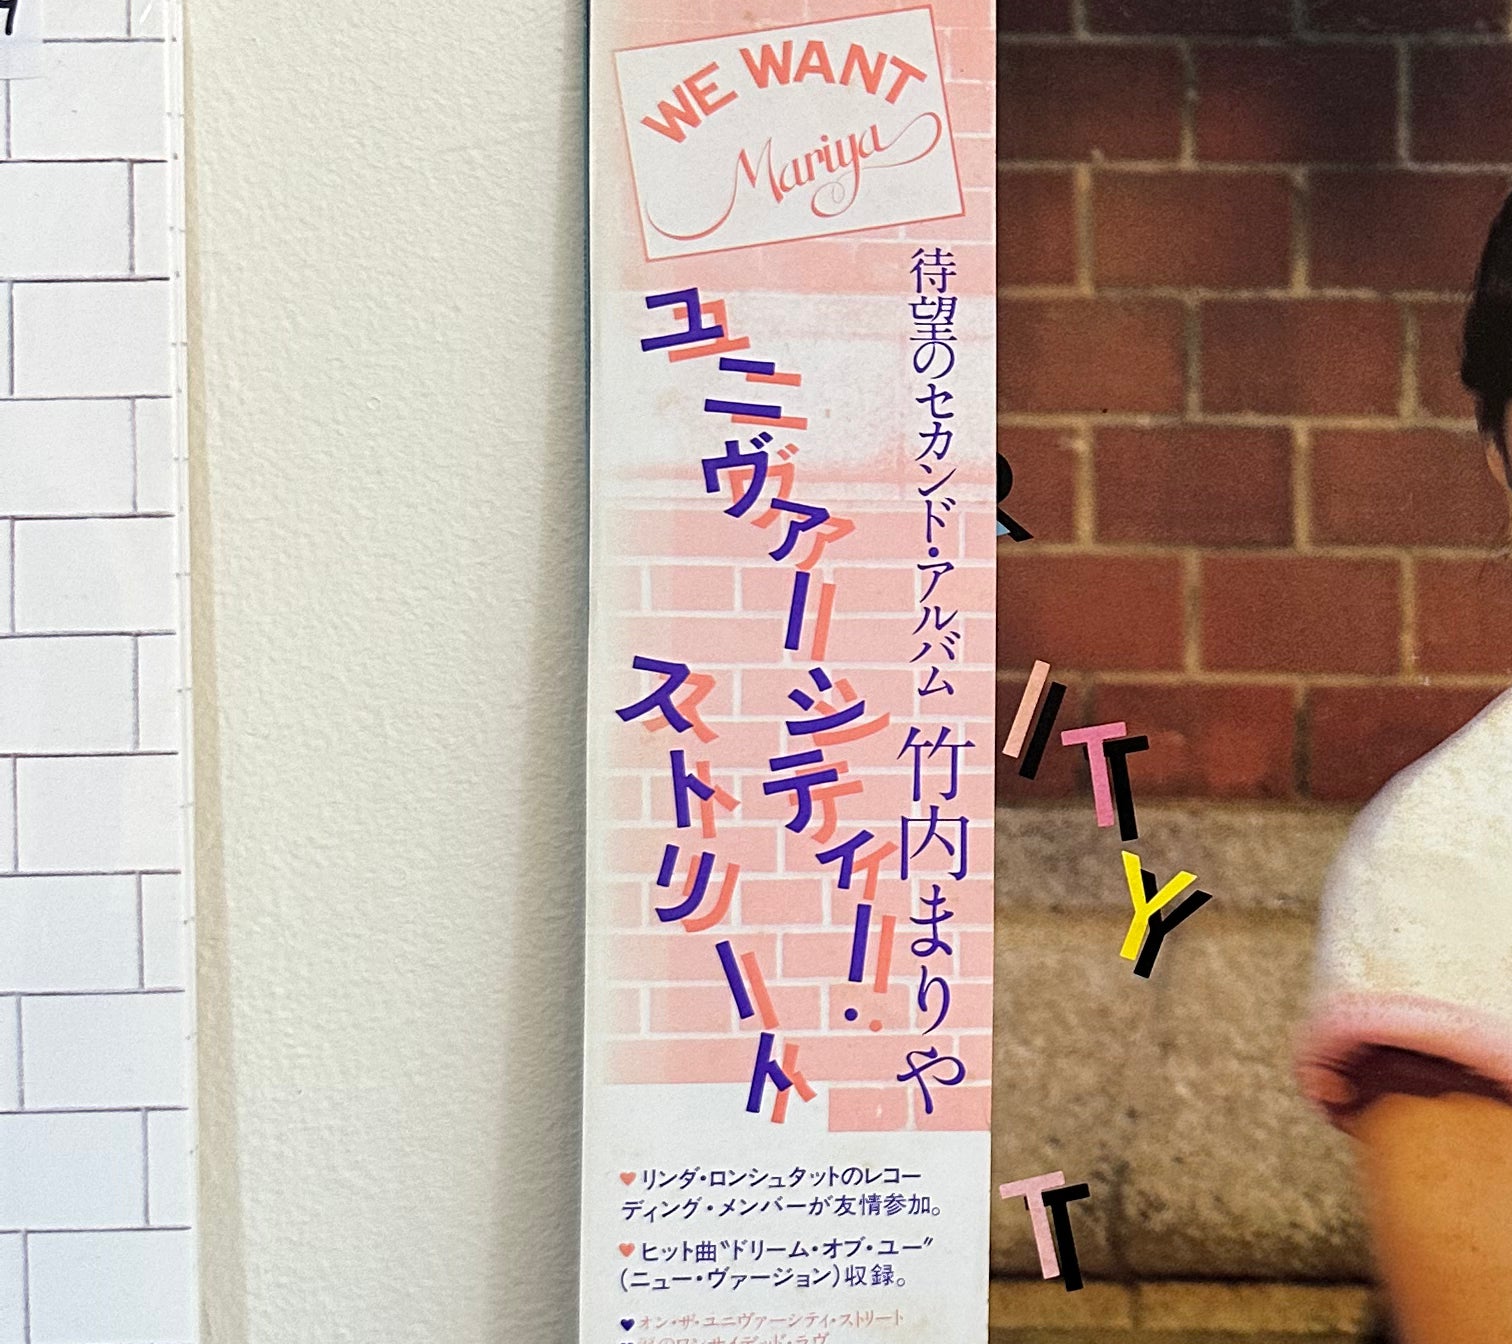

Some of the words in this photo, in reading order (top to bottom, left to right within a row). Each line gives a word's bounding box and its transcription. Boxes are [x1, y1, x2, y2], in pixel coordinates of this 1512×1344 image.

[641, 62, 738, 144] WE
[740, 40, 928, 105] WANT
[646, 112, 942, 242] Mariya
[908, 247, 960, 697] 待望のセカンド・アルバム
[616, 656, 816, 1123] ストリート
[896, 726, 975, 1115] 竹内まりや
[621, 1193, 941, 1223] ディング・メンバーが友情参加。
[643, 1166, 921, 1190] リンダ・ロンシュタットのレコー
